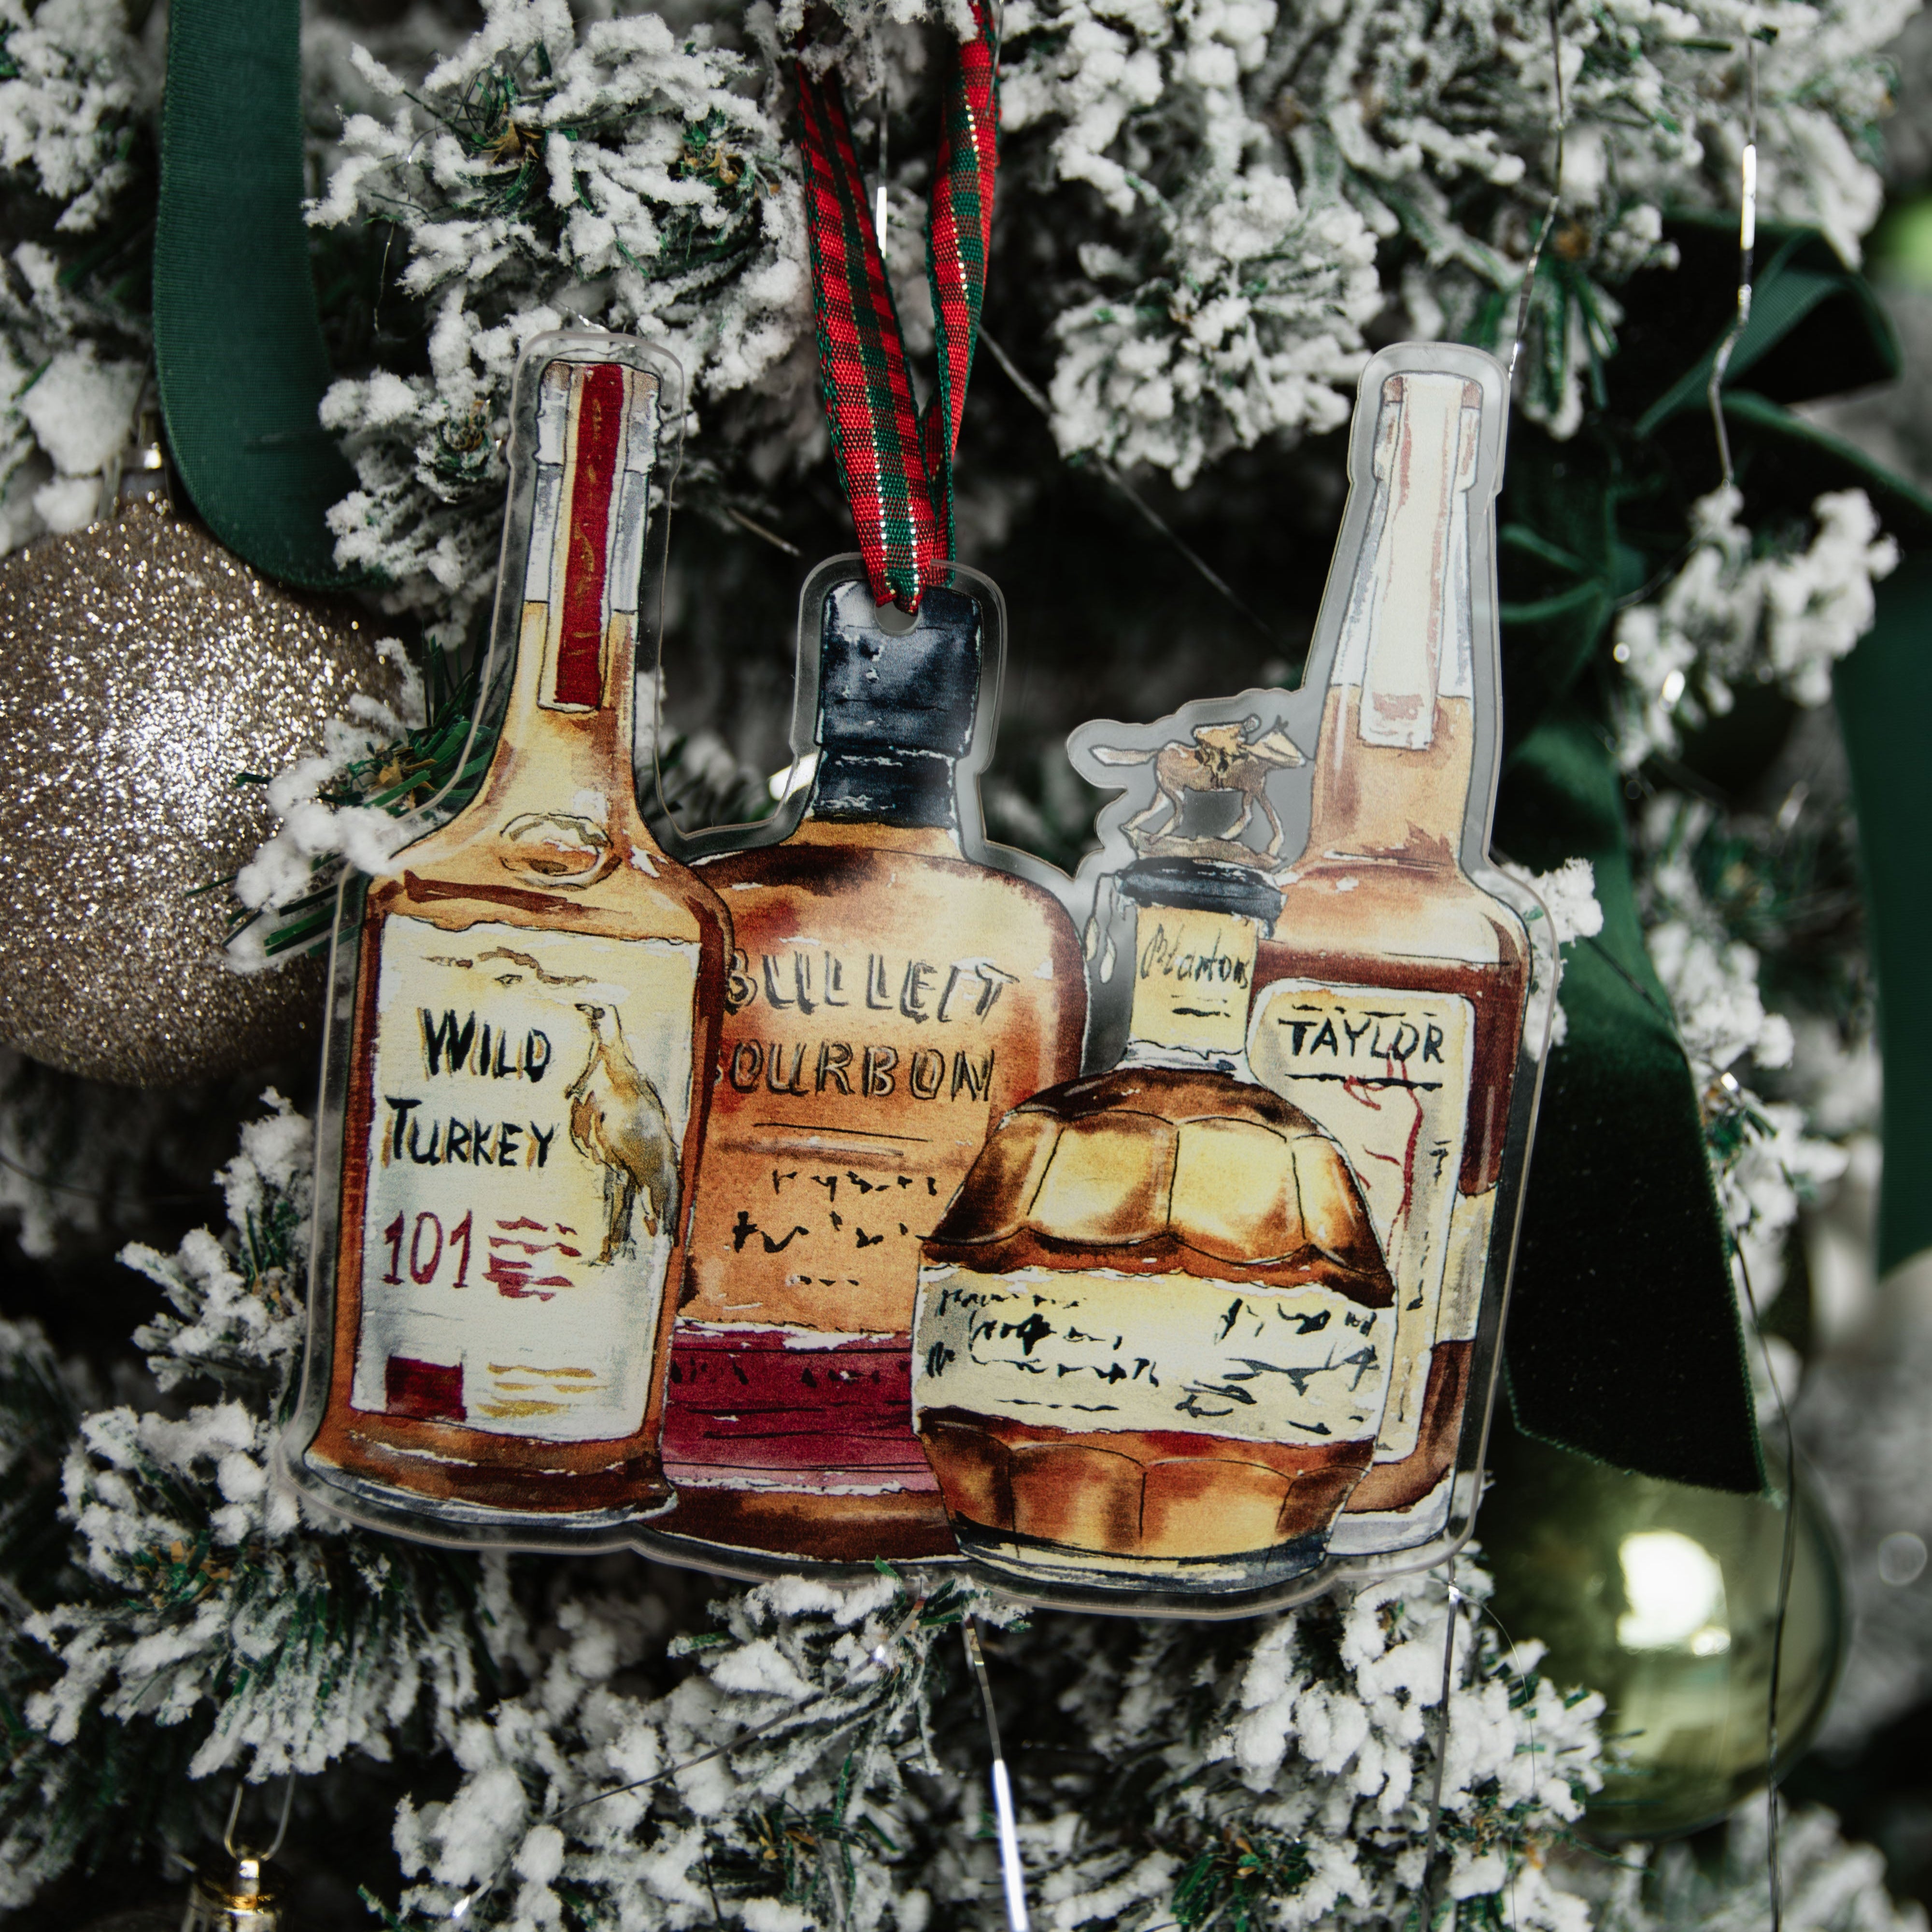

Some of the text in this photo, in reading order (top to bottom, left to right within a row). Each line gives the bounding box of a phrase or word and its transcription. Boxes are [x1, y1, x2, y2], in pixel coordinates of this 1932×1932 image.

[416, 1007, 552, 1083] WILD
[715, 1038, 995, 1101] OURBON
[1278, 1018, 1444, 1063] TAYLOR
[382, 1094, 556, 1169] TURKEY
[383, 1208, 473, 1289] 101
